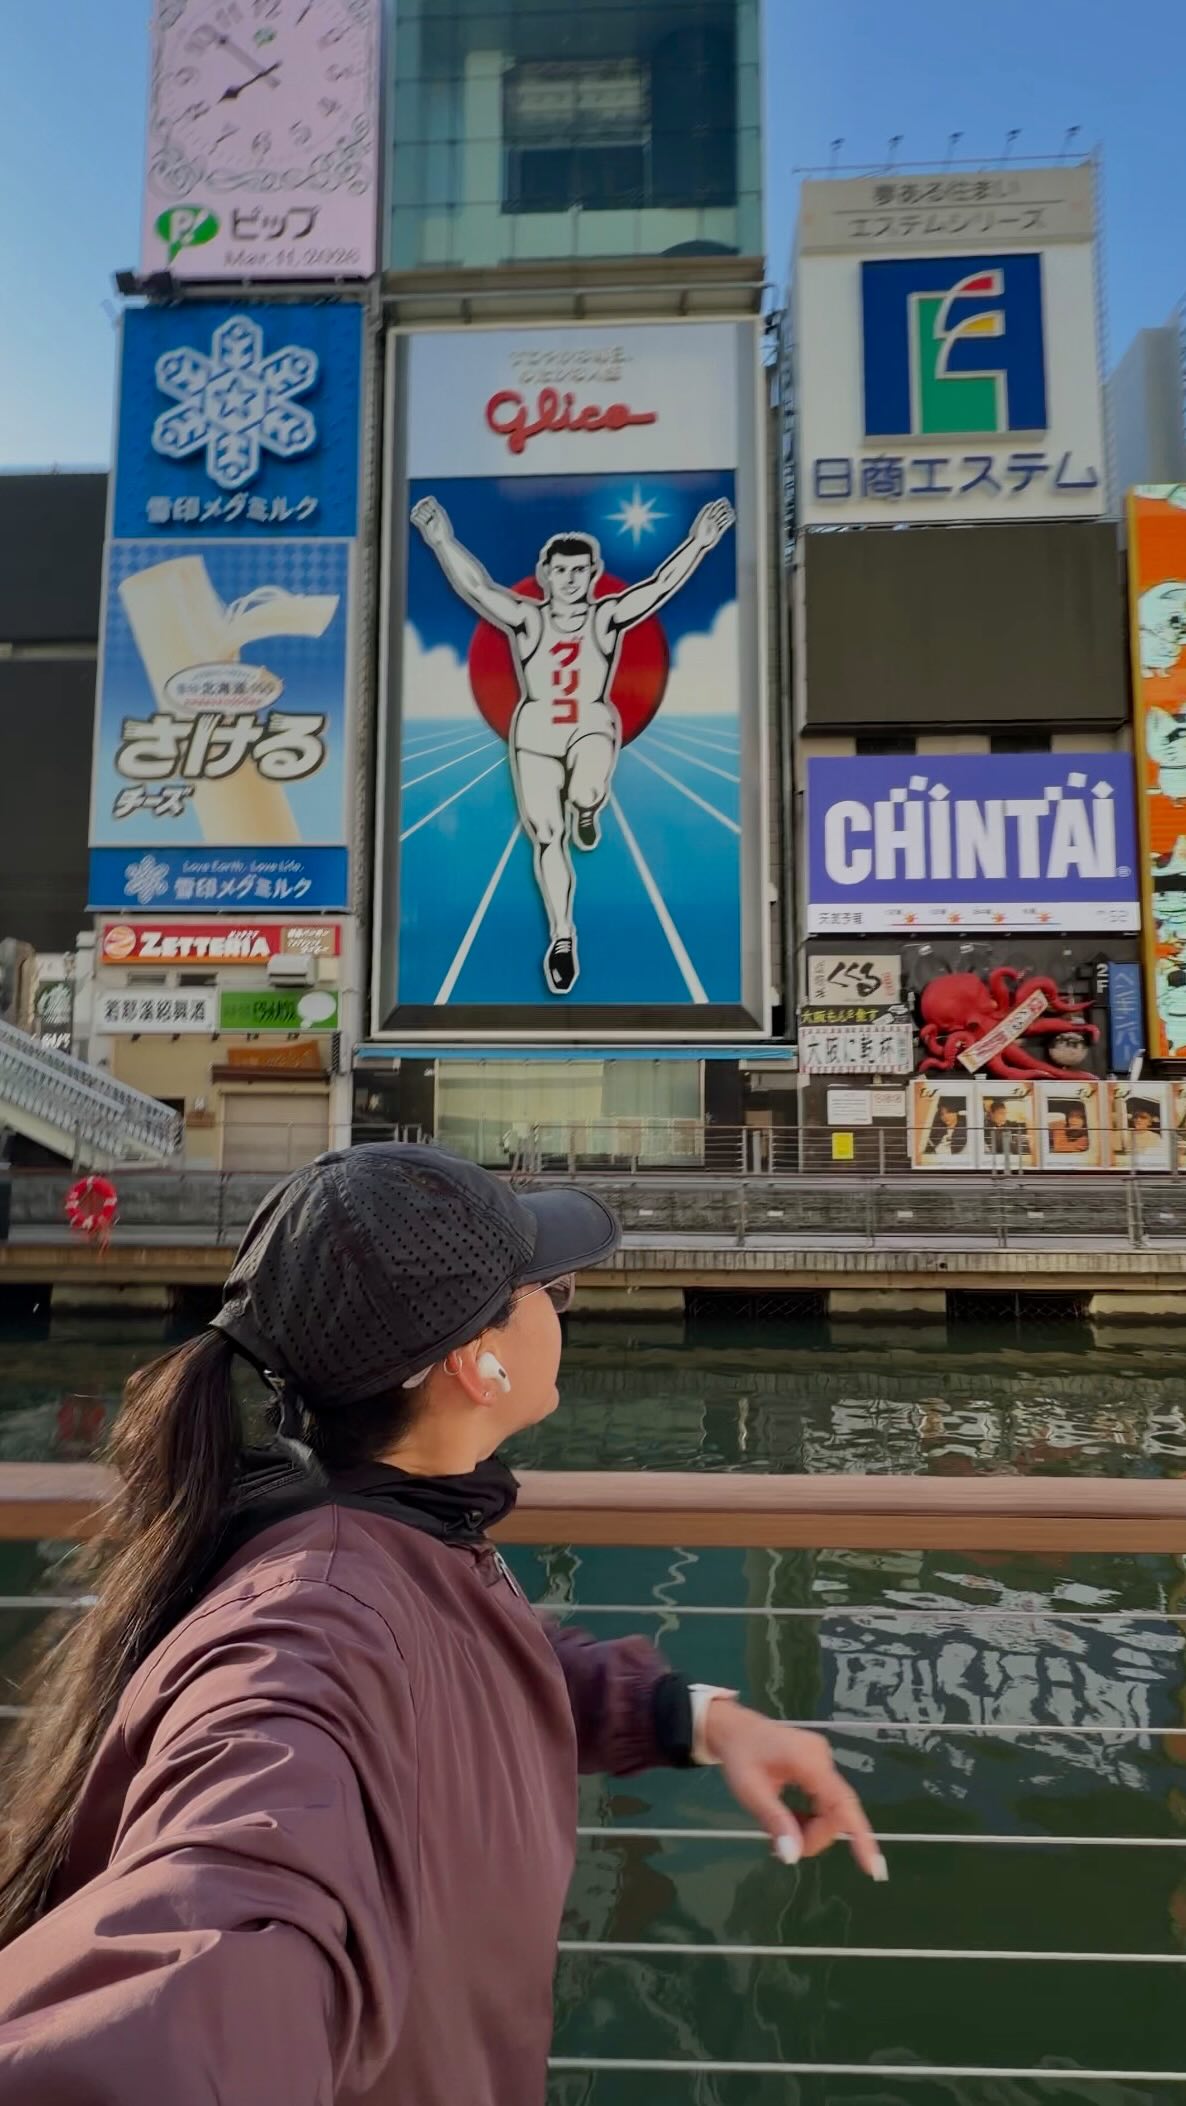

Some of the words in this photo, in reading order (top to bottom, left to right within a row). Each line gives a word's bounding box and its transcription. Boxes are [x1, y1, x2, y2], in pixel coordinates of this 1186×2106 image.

[814, 452, 1099, 501] 日商エステム
[549, 635, 583, 724] グリコ
[115, 710, 328, 781] さける
[113, 784, 195, 819] チーズ
